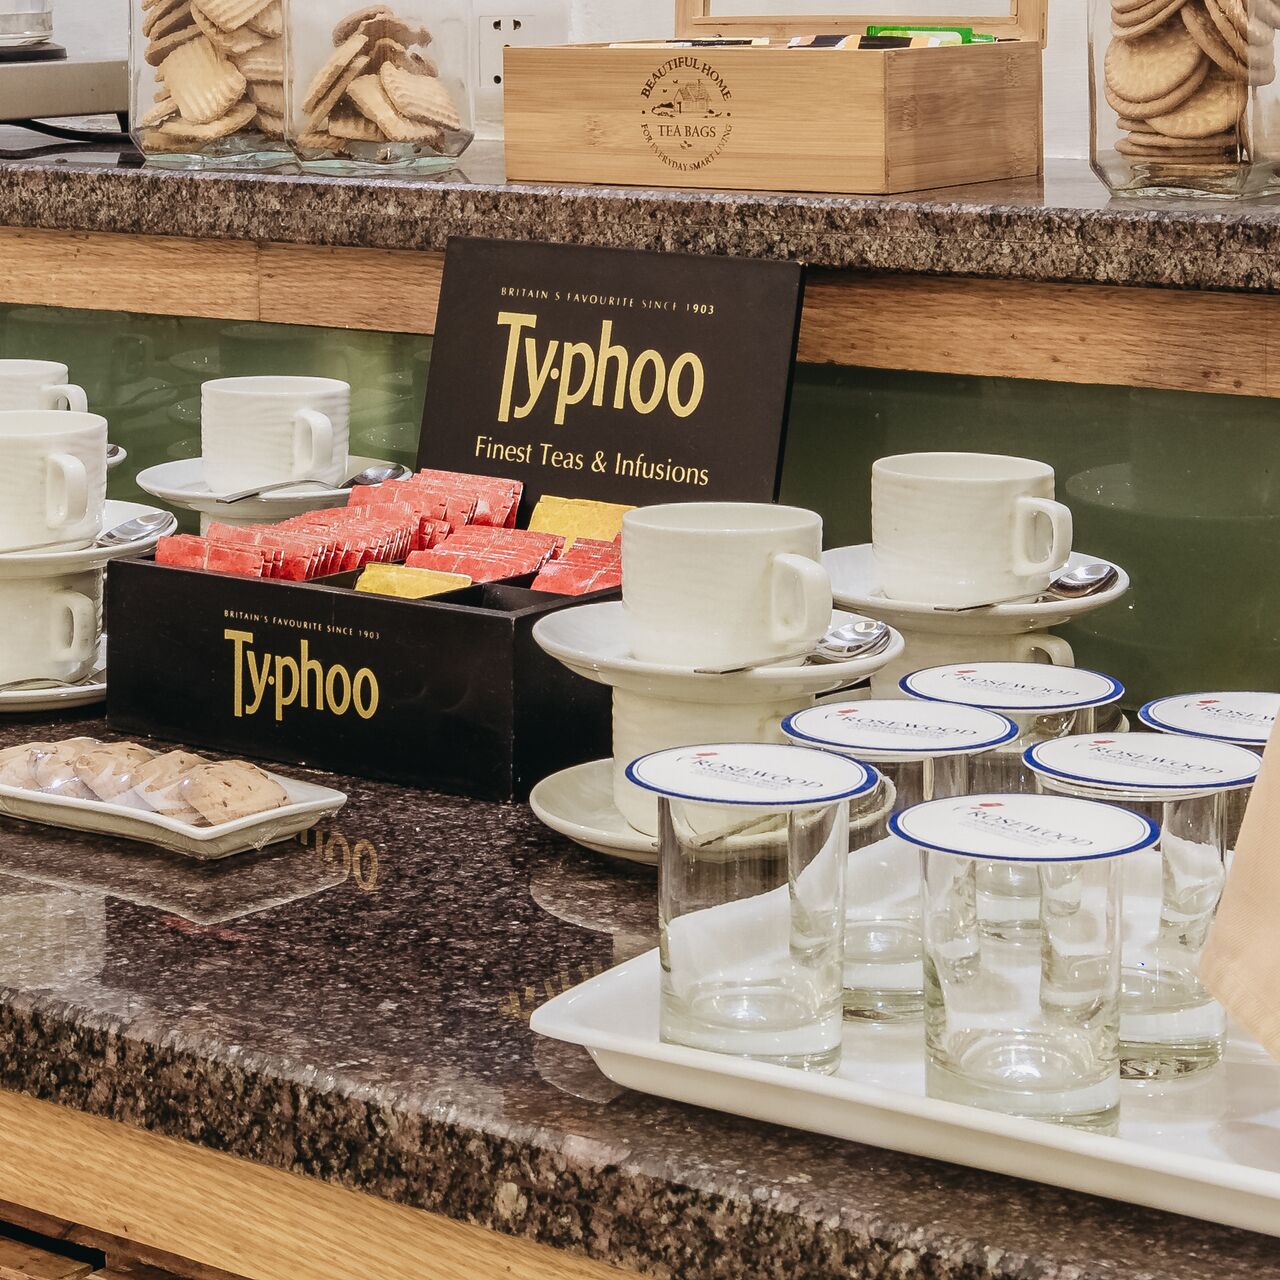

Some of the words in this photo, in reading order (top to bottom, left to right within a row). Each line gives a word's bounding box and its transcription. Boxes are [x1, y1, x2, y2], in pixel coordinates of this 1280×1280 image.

[640, 56, 700, 99] BEAUTIFUL
[701, 63, 732, 101] HOME
[658, 125, 681, 137] TEA
[685, 125, 716, 137] BAGS
[641, 123, 653, 143] FOR
[650, 142, 688, 171] EVERYDAY
[689, 153, 715, 171] SMART
[715, 123, 733, 155] LIVING
[567, 291, 635, 308] FAVOURITE
[686, 303, 715, 315] 1903
[475, 435, 533, 464] Finest
[540, 443, 584, 470] Teas
[590, 450, 607, 473] &
[615, 452, 709, 486] Infusions
[223, 609, 269, 624] BRITAIN'S
[272, 616, 322, 632] FAVOURITE
[326, 624, 353, 636] SINCE
[358, 629, 380, 640] 1903
[957, 676, 1080, 696] ROSEWOOD
[842, 716, 977, 735] ROSEWOOD
[1200, 706, 1276, 722] ROSEW
[693, 759, 824, 788] ROSEWOOD
[1089, 746, 1224, 774] ROSEWOOD
[967, 810, 1094, 847] ROSEWOOD
